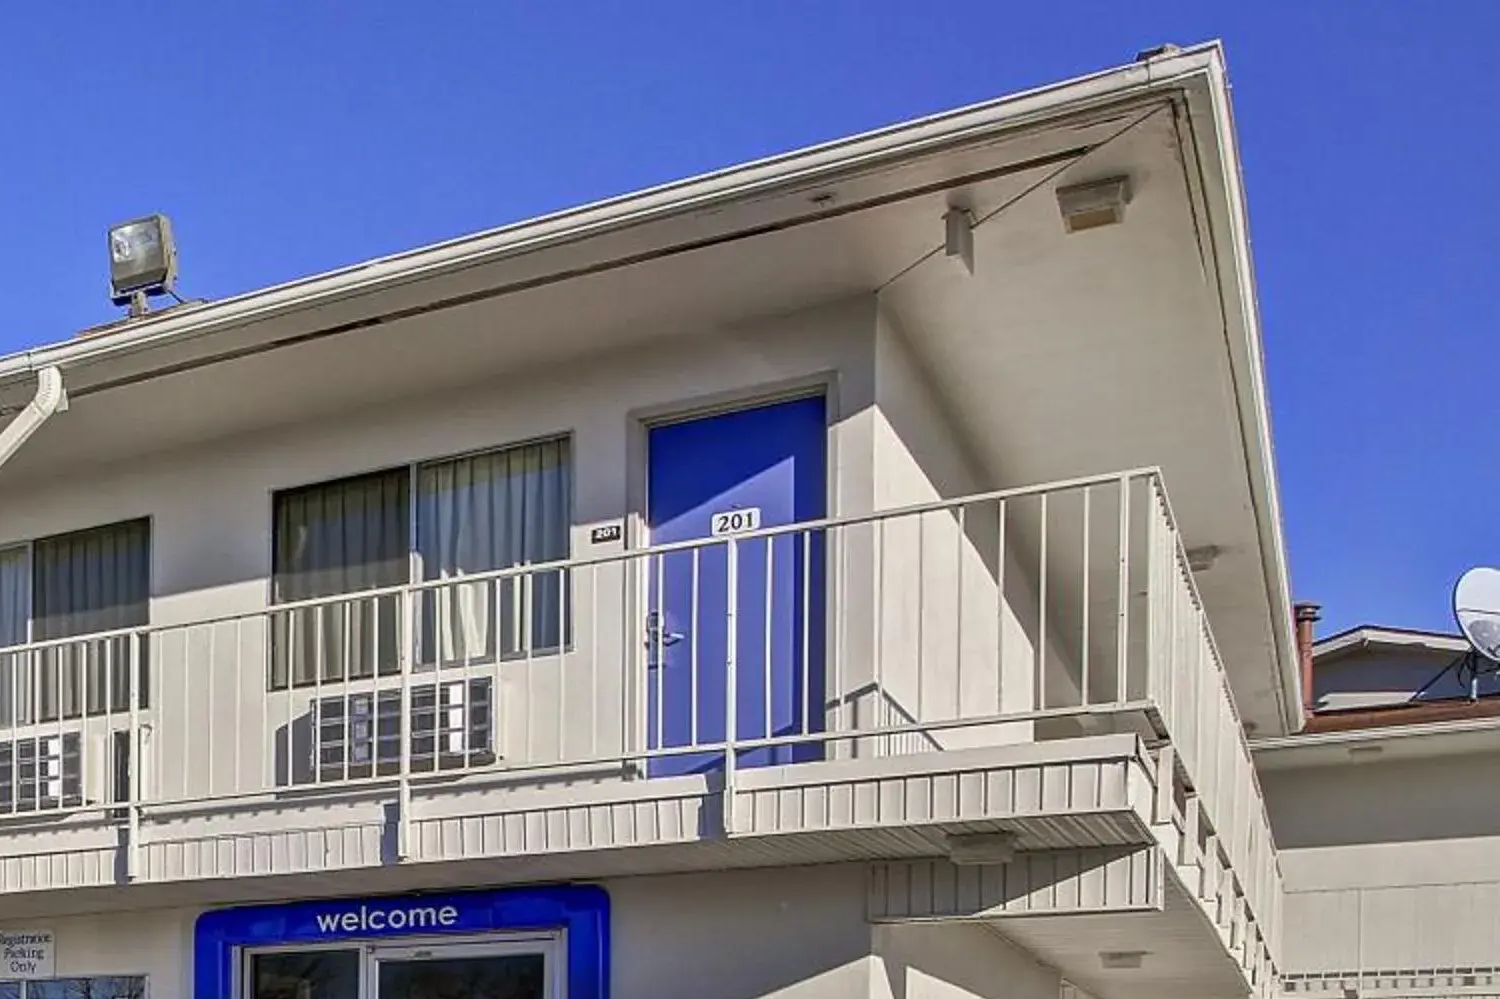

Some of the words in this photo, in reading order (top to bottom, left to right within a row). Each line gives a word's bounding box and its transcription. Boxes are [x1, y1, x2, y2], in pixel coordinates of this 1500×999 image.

[718, 512, 753, 532] 201
[595, 527, 617, 539] 201
[317, 905, 457, 932] welcome
